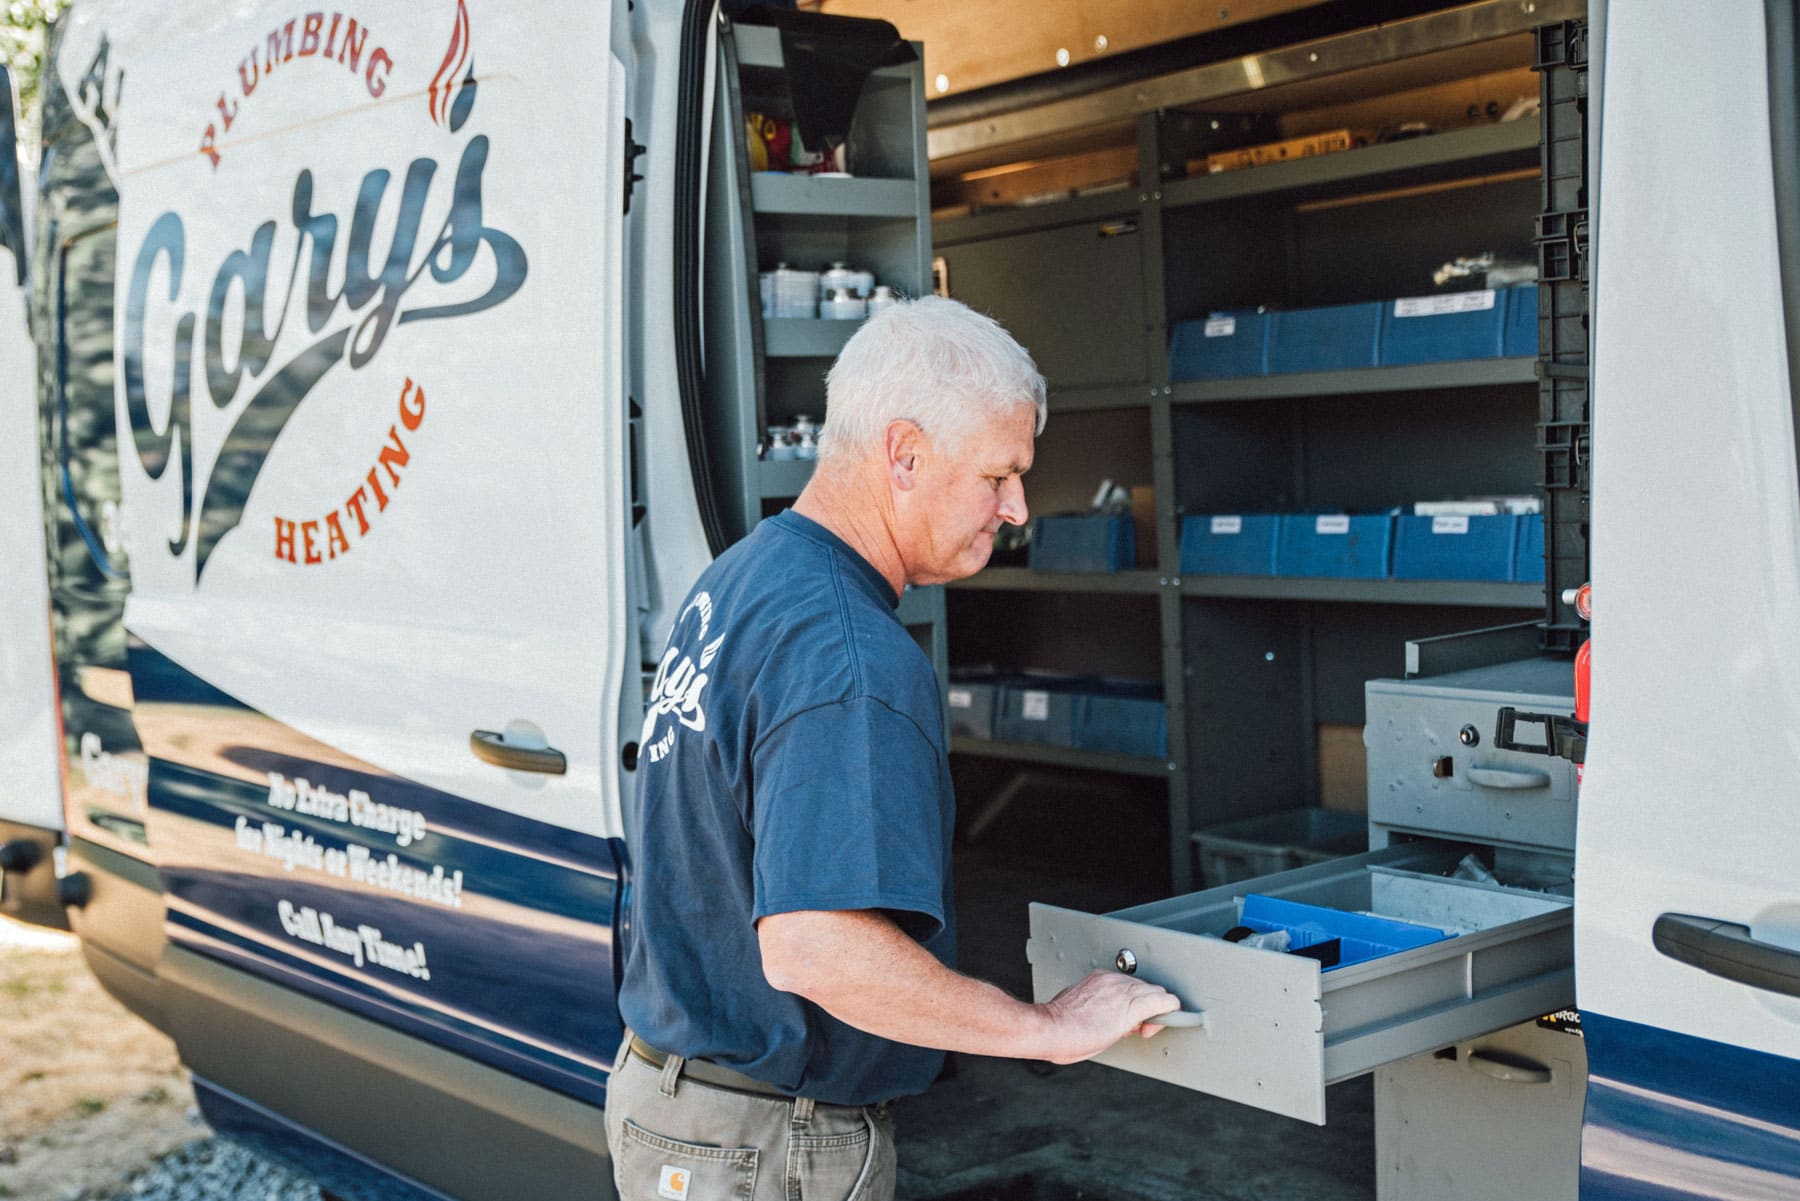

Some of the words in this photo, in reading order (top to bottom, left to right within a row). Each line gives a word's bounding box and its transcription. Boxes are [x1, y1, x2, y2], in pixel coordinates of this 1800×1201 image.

[200, 12, 393, 170] PLUMBING
[274, 377, 425, 565] HEATING
[267, 771, 297, 811] No
[294, 777, 349, 823] Extra
[349, 788, 426, 847] Charge
[235, 815, 263, 853] for
[262, 822, 324, 872] Nights
[324, 847, 347, 877] or
[346, 843, 463, 908] Weekends!
[278, 899, 324, 946] Call
[319, 912, 364, 968] Any
[357, 924, 431, 981] Time!
